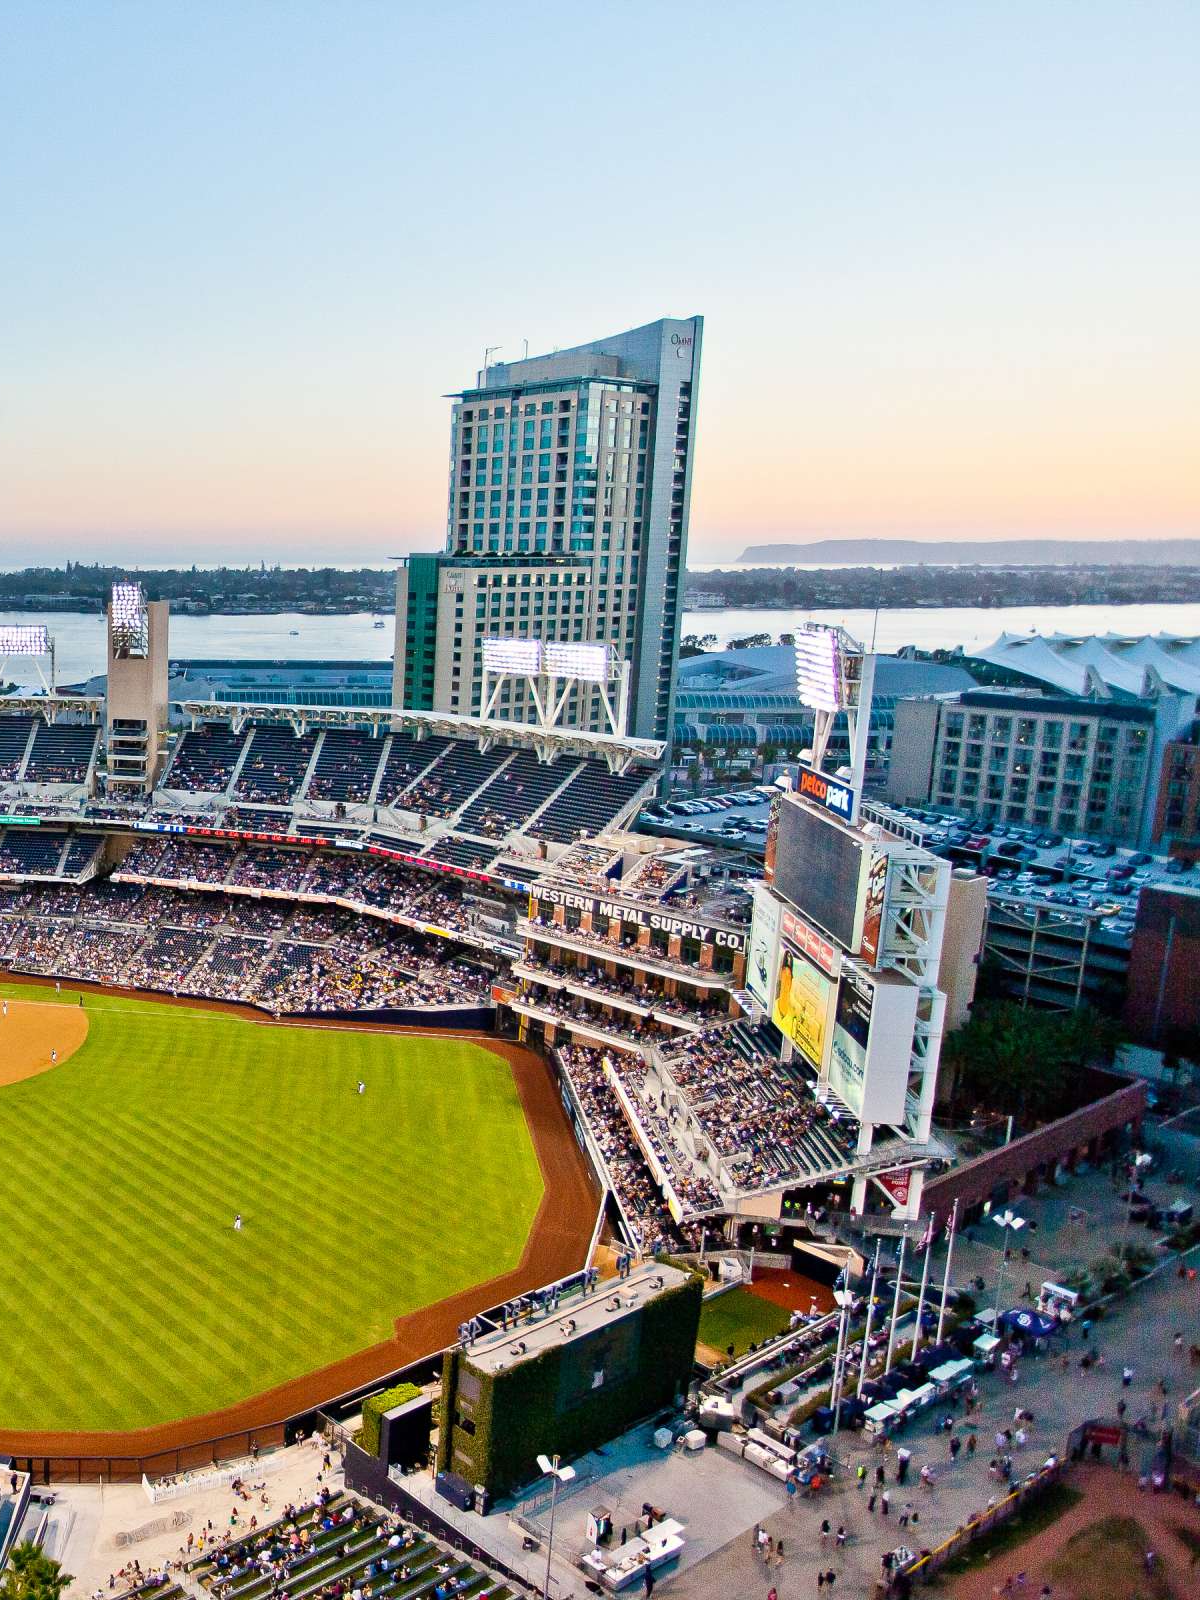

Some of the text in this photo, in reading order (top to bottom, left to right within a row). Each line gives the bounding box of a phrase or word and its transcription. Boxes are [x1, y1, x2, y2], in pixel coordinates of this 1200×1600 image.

[801, 771, 849, 812] petco park
[532, 884, 744, 950] WESTERN METAL SUPPLY CO.
